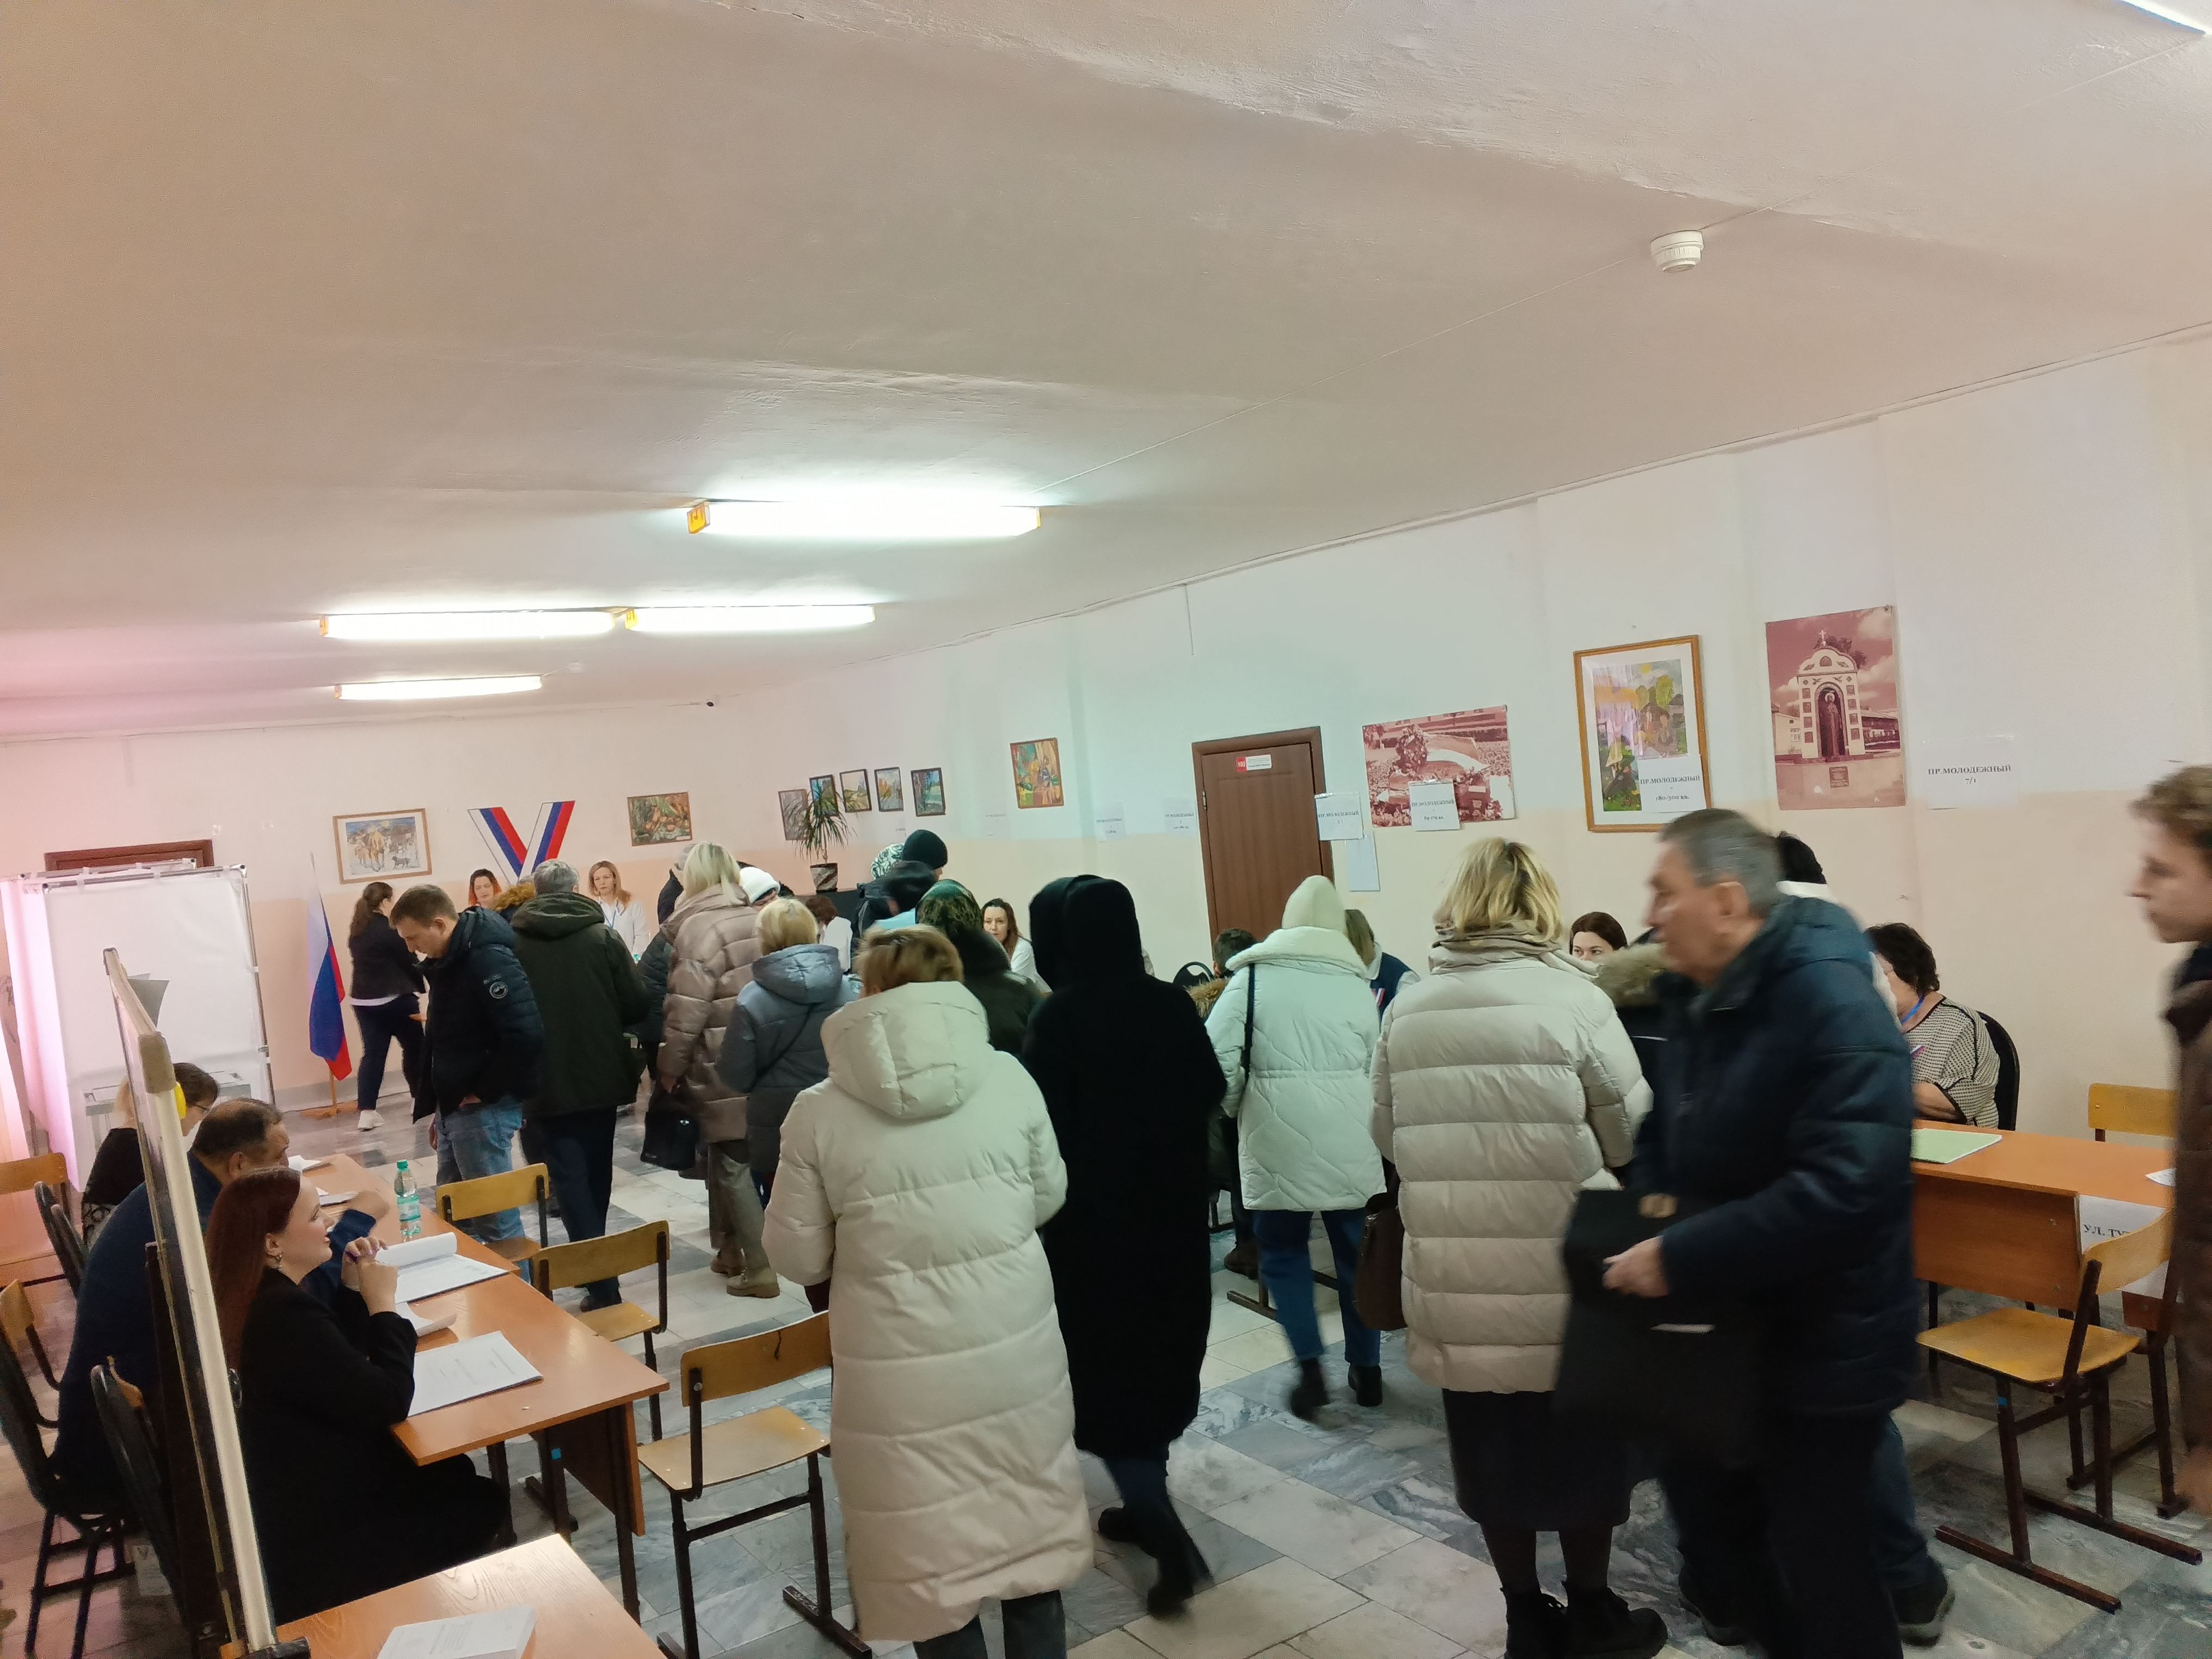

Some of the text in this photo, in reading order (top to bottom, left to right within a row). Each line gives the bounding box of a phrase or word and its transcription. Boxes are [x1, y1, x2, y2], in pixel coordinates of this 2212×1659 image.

[1928, 764, 2011, 775] ПР.МОЛОДЕЖНЫЙ
[1640, 775, 1700, 784] ПР.МОЛОДЕЖНЫЙ
[1965, 777, 1976, 785] 7/1
[2082, 1224, 2130, 1238] УЛ. ТУ
